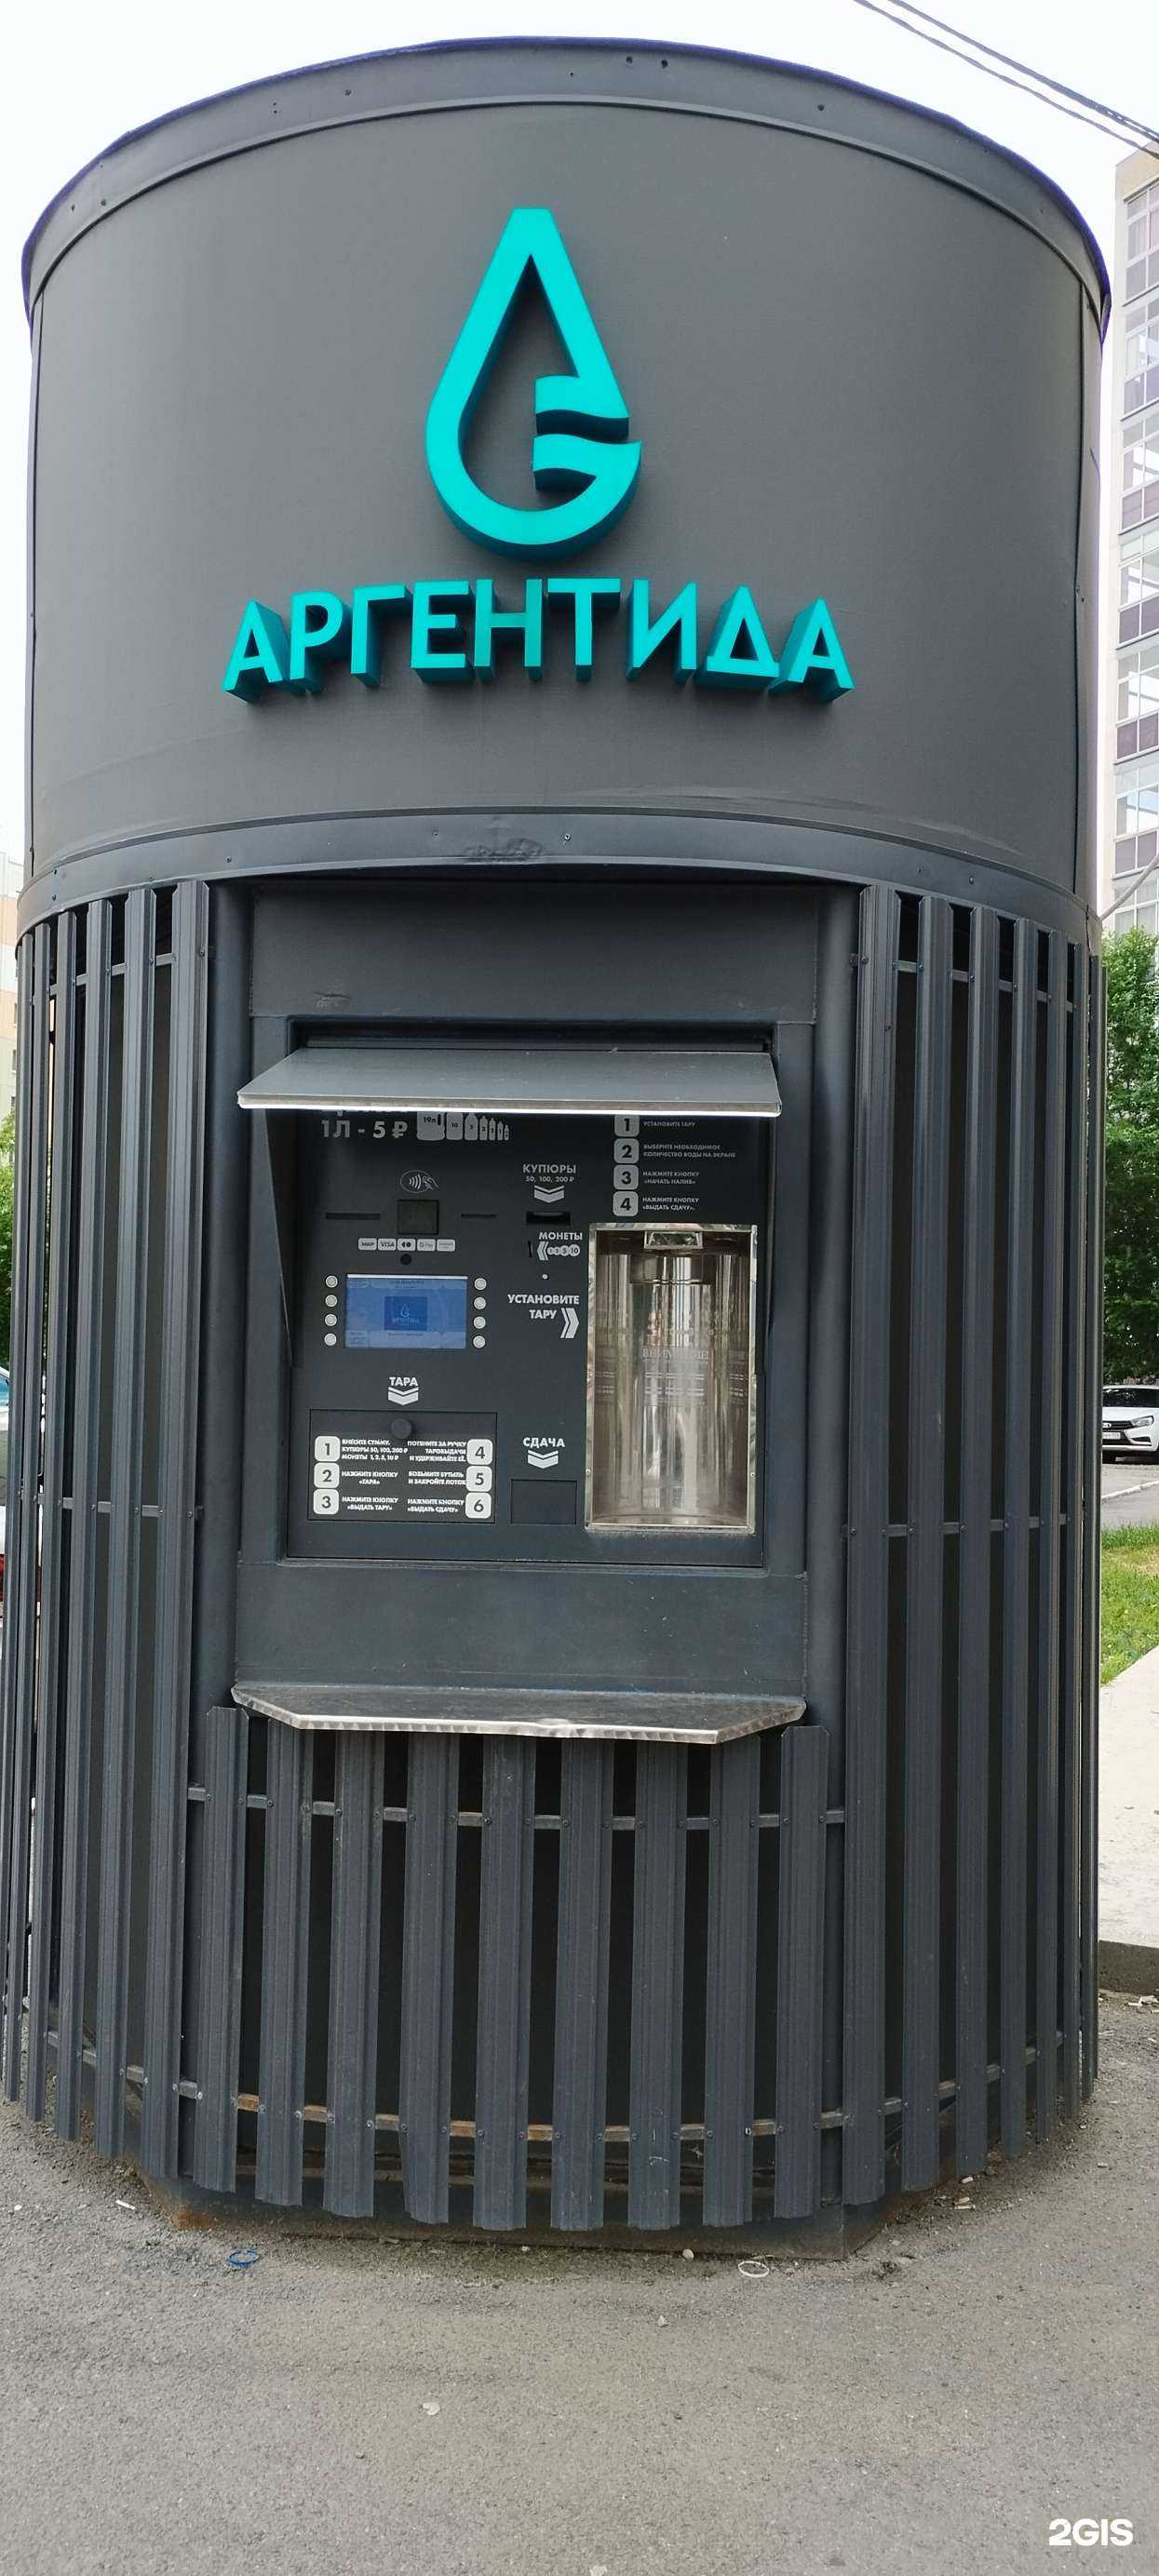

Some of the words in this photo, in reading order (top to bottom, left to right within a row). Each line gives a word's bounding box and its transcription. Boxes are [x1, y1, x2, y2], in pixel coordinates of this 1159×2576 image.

[223, 578, 855, 704] АРГЕНТИДА
[321, 1120, 351, 1138] 1Л
[373, 1120, 385, 1139] 5
[624, 1118, 630, 1132] 1
[622, 1145, 632, 1159] 2
[522, 1163, 577, 1174] КУПЮРЫ
[621, 1171, 632, 1185] 3
[620, 1197, 632, 1211] 4
[539, 1231, 583, 1241] МОНЕТЫ
[507, 1294, 580, 1305] УСТАНОВИТЕ
[529, 1309, 558, 1320] ТАРУ
[389, 1376, 419, 1387] ТАРА
[324, 1442, 330, 1456] 1
[522, 1437, 566, 1449] СДАЧА
[475, 1445, 486, 1459] 4
[322, 1469, 332, 1483] 2
[475, 1472, 484, 1486] 5
[321, 1496, 331, 1509] 3
[474, 1499, 484, 1513] 6
